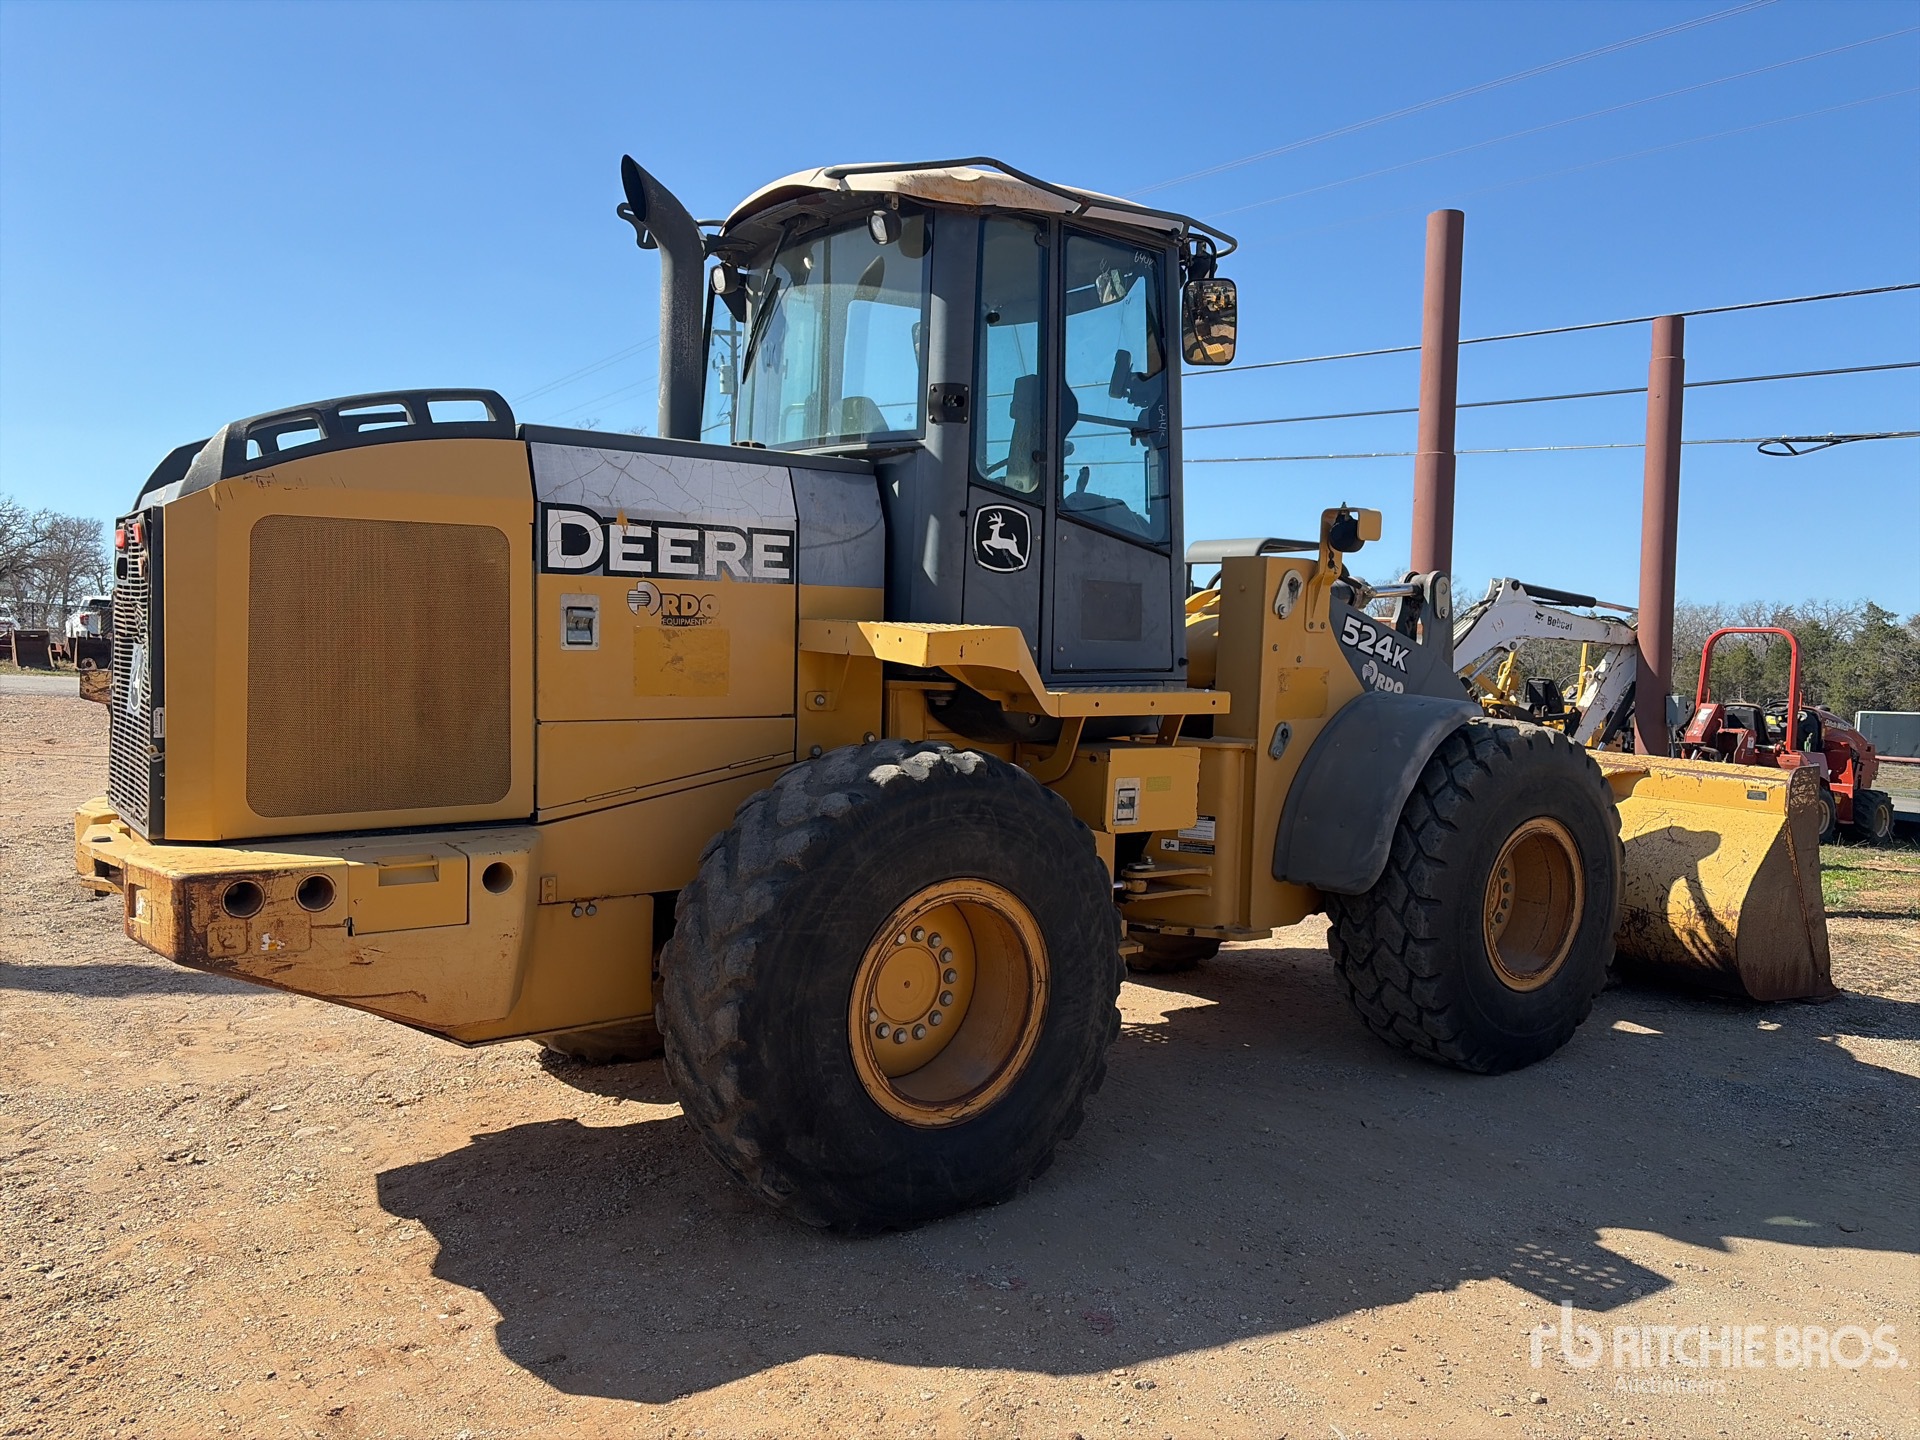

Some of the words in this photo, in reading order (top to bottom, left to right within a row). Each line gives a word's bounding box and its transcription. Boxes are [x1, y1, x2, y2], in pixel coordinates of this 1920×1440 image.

[547, 509, 790, 579] DEERE
[662, 617, 704, 627] EQUIPMENT
[1547, 615, 1573, 631] Bobcat
[1341, 613, 1411, 673] 524K
